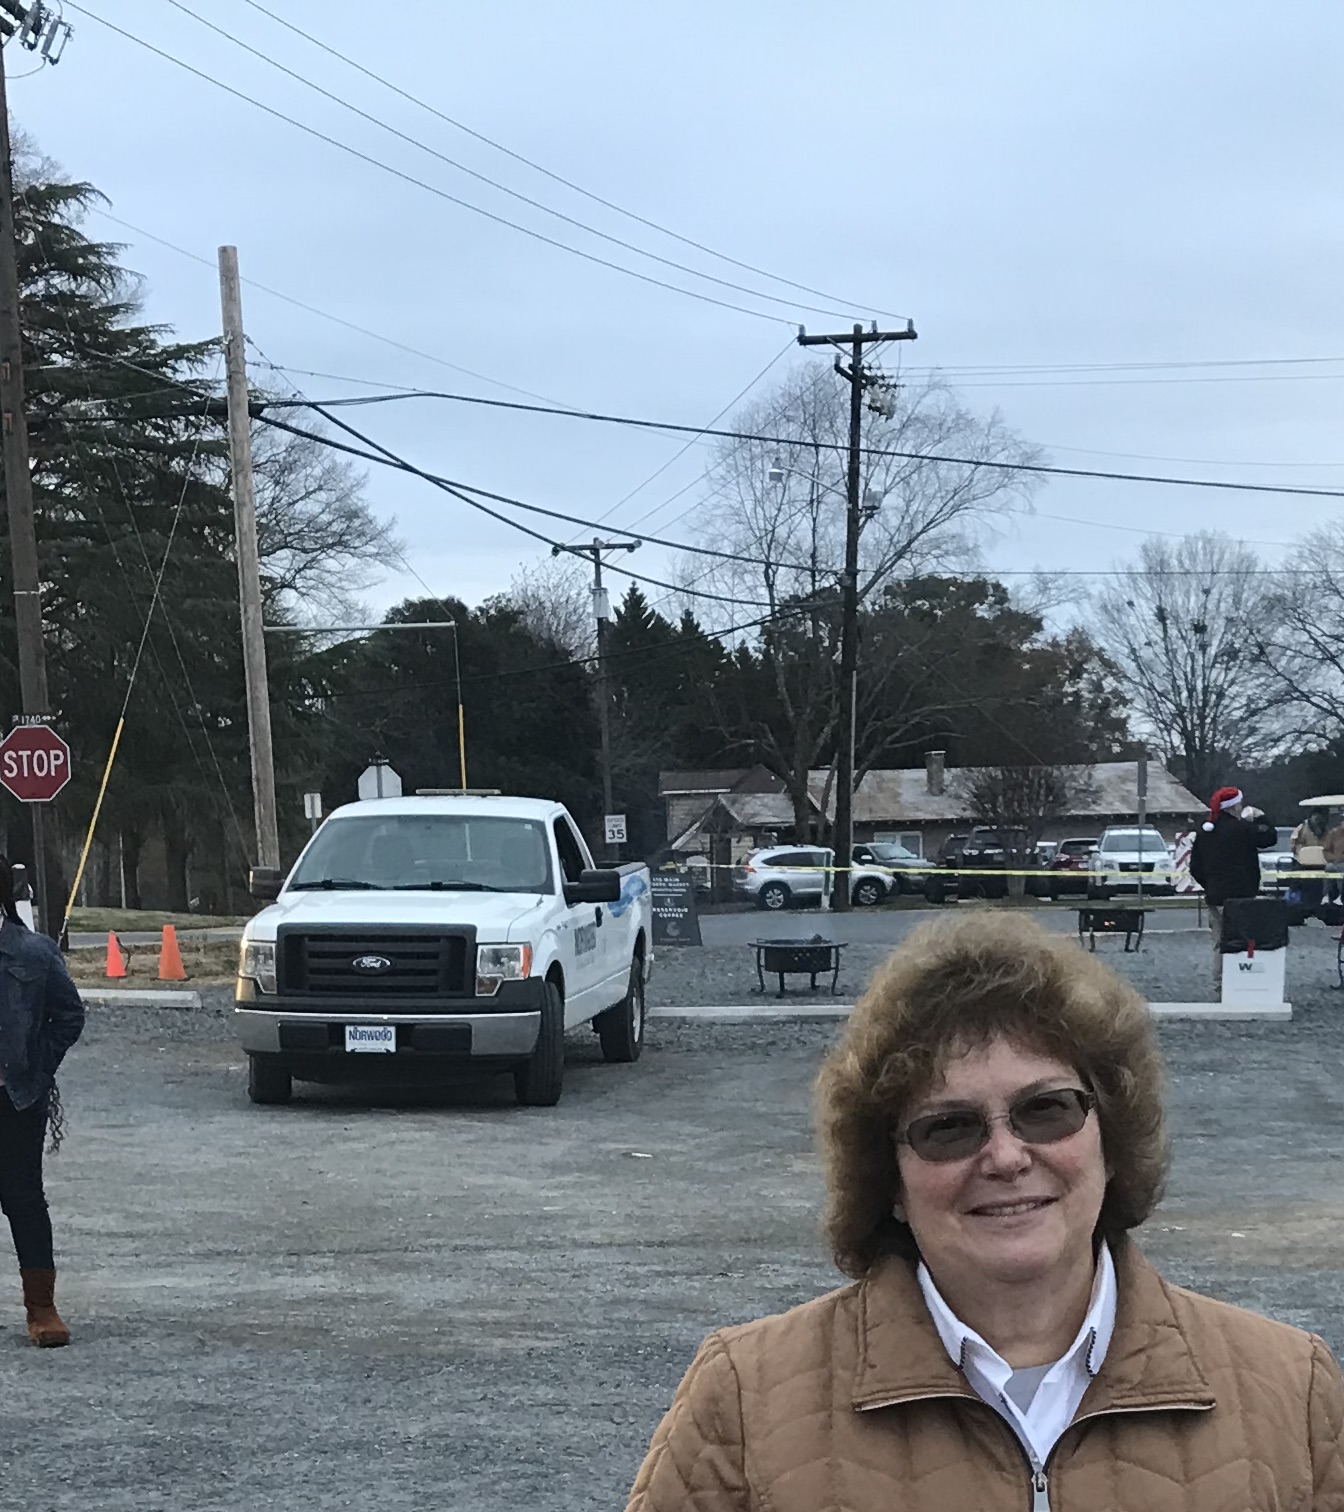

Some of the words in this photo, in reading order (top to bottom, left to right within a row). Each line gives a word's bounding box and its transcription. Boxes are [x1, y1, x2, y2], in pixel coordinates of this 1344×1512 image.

[3, 749, 65, 778] STOP
[608, 828, 625, 840] 35
[348, 1029, 394, 1041] NORWOOD
